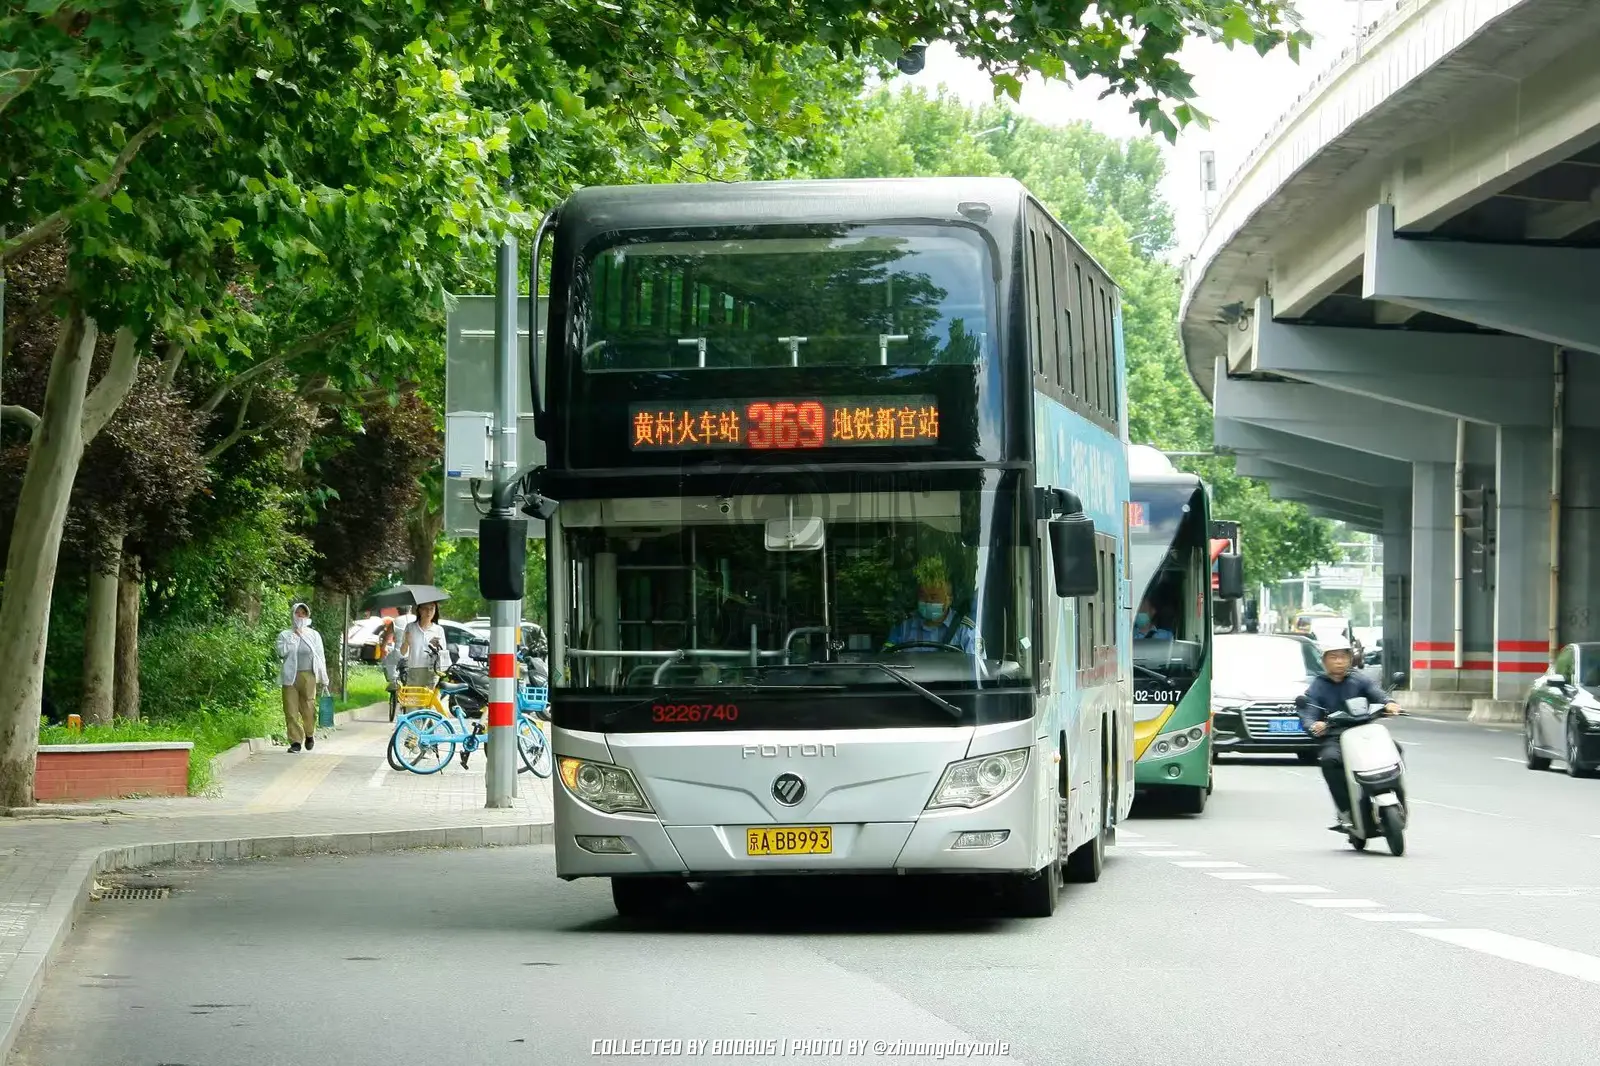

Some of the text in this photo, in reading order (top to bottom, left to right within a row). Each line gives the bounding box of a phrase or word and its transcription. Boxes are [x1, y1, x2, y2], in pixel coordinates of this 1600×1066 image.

[634, 402, 939, 448] 黄村火车站 369 地铁新宫站
[652, 704, 739, 723] 3226740
[741, 743, 837, 760] FOTON
